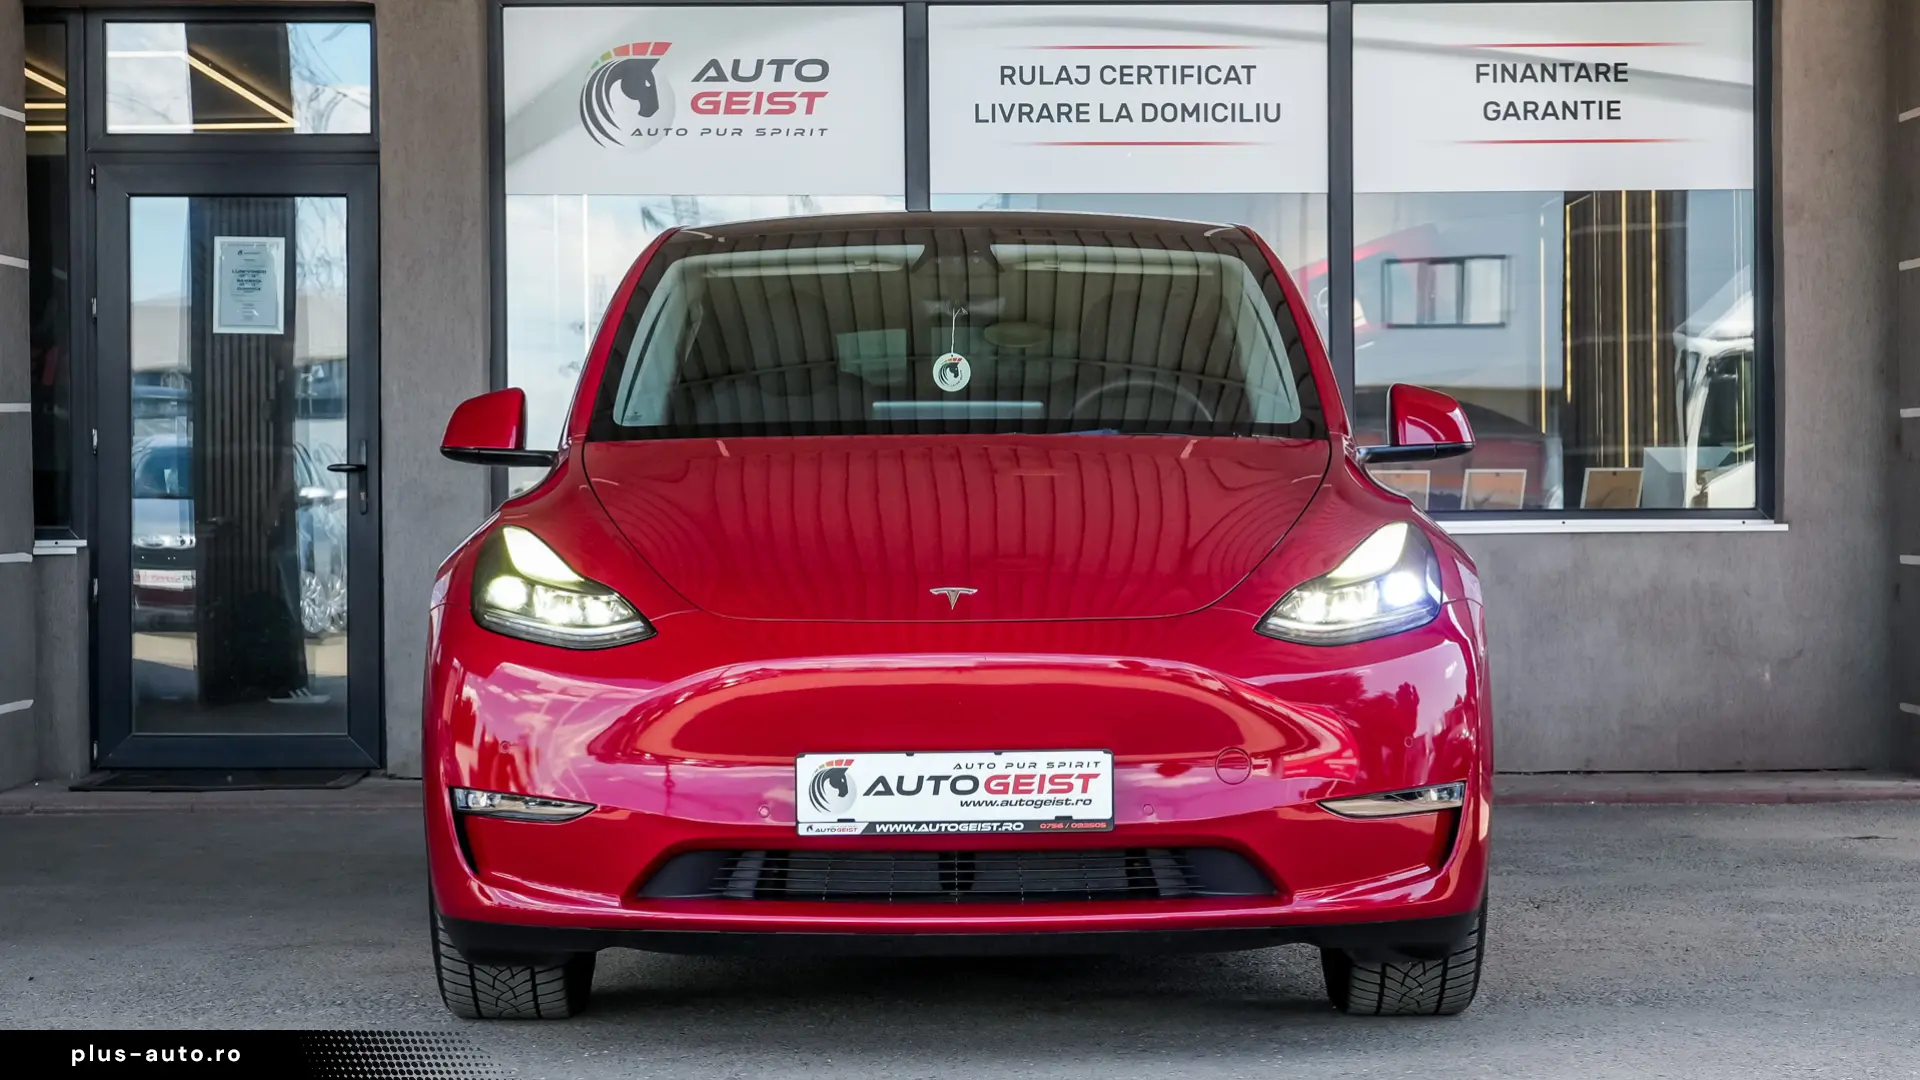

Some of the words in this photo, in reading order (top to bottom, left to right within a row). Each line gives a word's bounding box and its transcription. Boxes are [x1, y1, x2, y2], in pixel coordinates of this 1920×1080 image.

[690, 58, 830, 83] AUTO
[1000, 65, 1091, 85] RULAJ
[1099, 65, 1257, 85] CERTIFICAT
[1475, 62, 1629, 84] FINANTARE
[690, 91, 829, 115] GEIST
[974, 102, 1091, 123] LIVRARE
[1098, 102, 1134, 123] LA
[1141, 102, 1282, 123] DOMICILIU
[1482, 100, 1622, 121] GARANTIE
[630, 127, 688, 137] AUTO
[700, 127, 743, 137] PUR
[754, 127, 829, 137] SPIRIT
[953, 762, 996, 770] AUTO
[1005, 761, 1037, 769] PUR
[1046, 760, 1101, 769] SPIRIT
[862, 773, 1101, 797] AUTOGEIST
[959, 796, 1093, 809] www.autogeist.ro
[875, 821, 1025, 833] WWW.AUTOGEIST.RO
